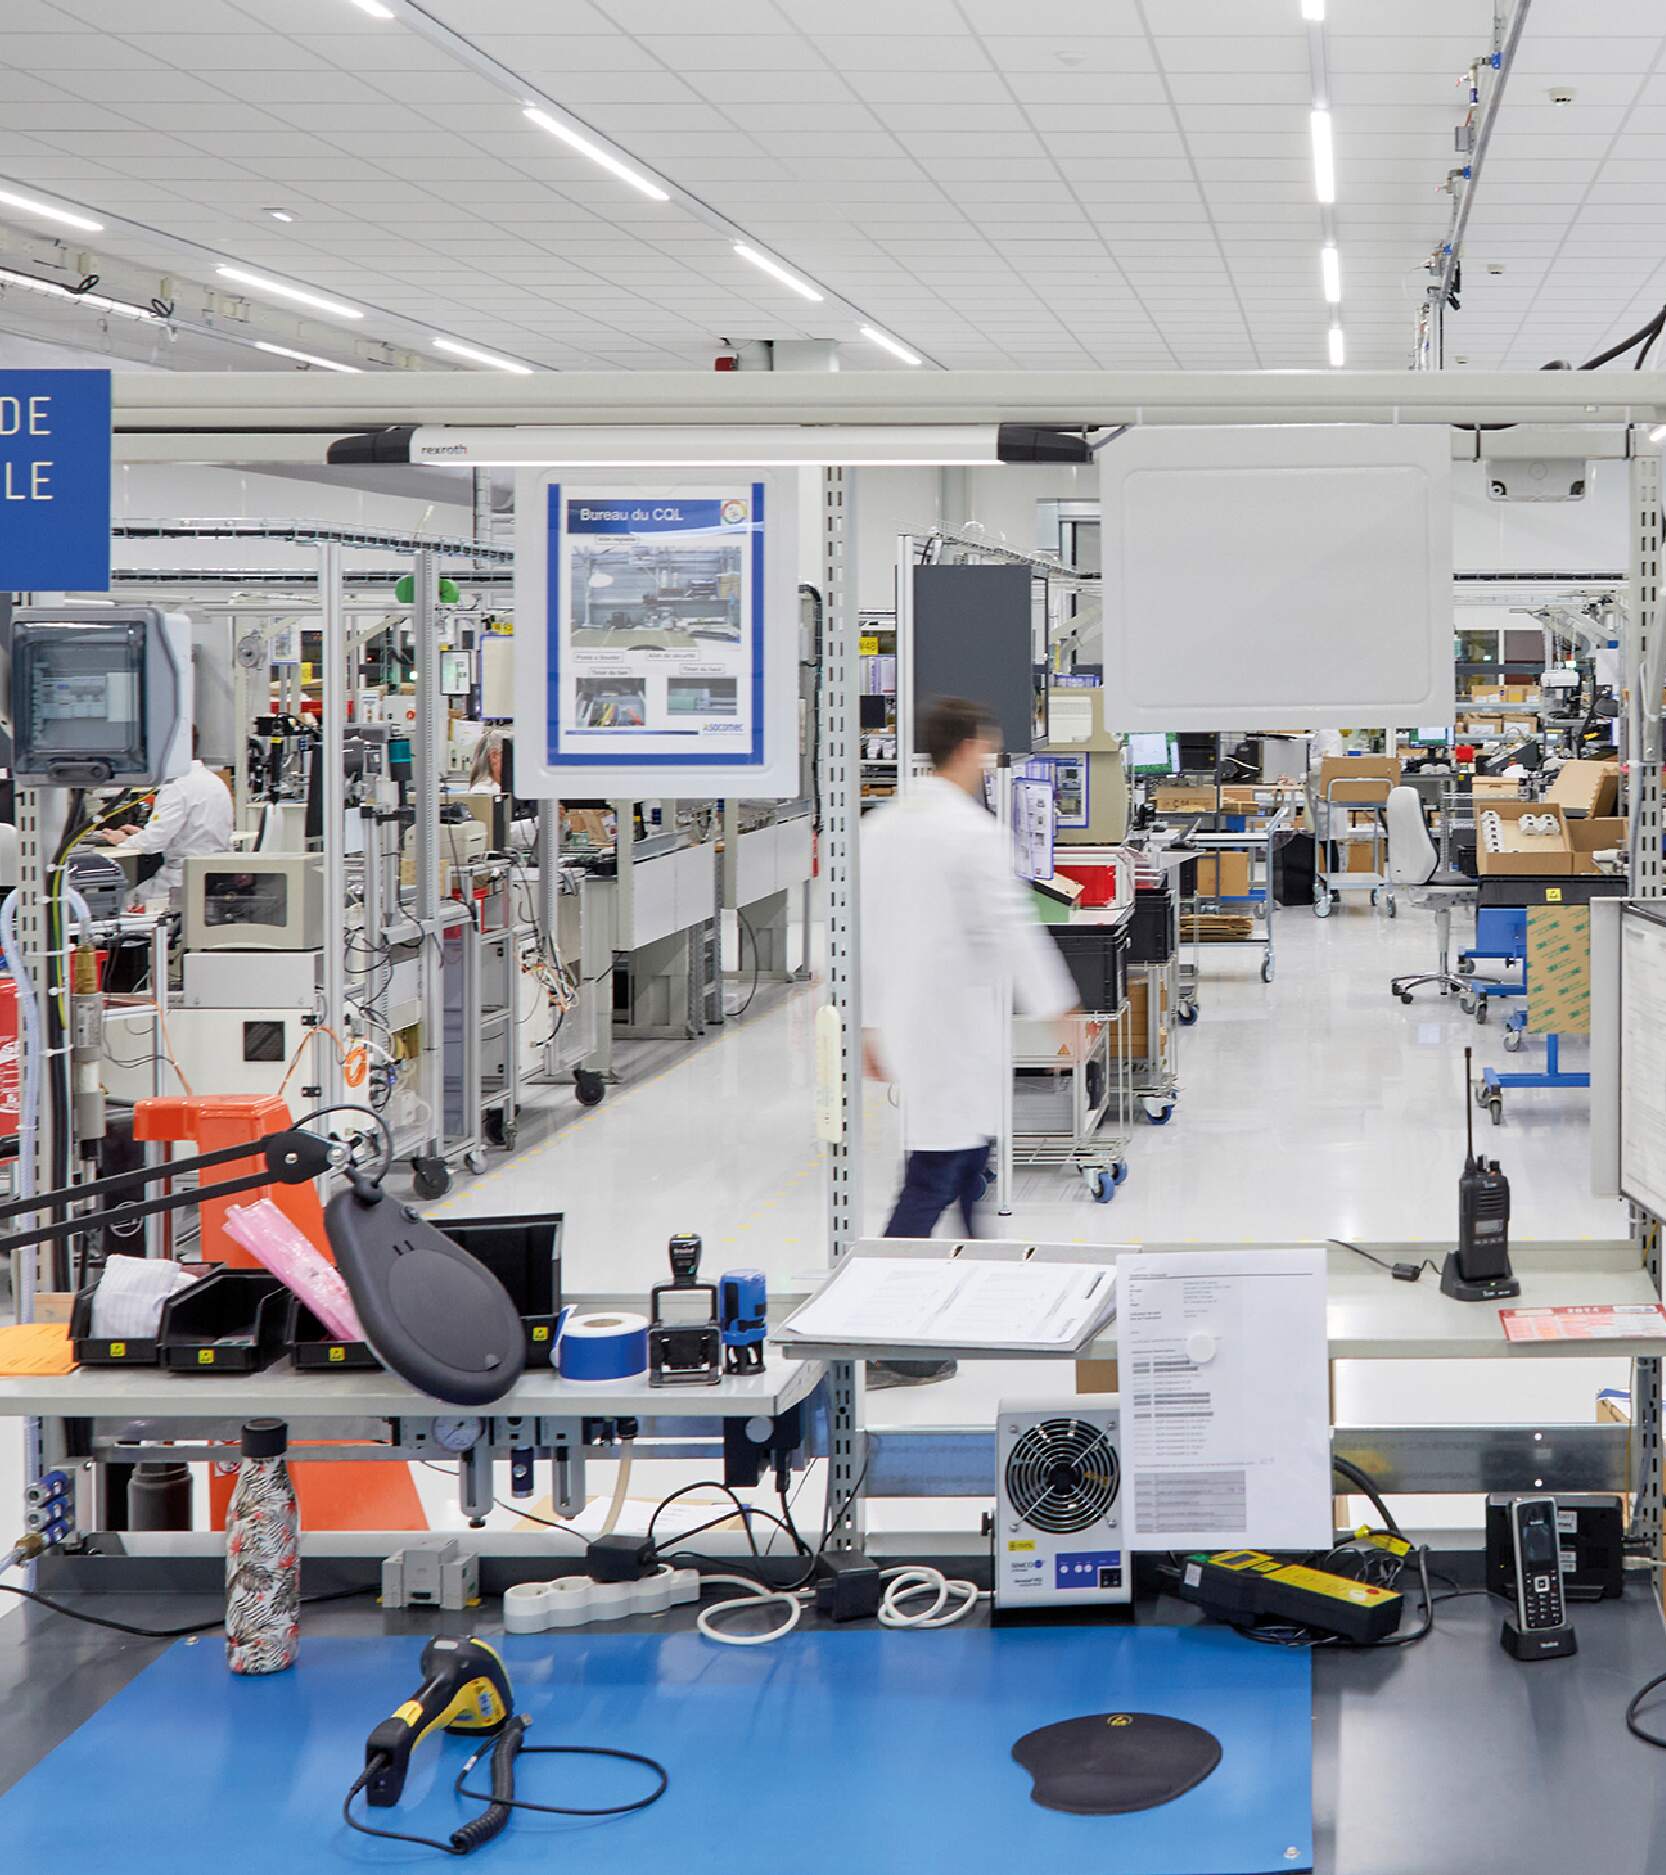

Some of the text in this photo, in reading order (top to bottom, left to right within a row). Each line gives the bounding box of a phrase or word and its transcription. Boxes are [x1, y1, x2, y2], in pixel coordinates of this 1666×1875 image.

[0, 396, 52, 436] DE
[5, 462, 54, 500] LE
[580, 508, 684, 521] Bureau du CQL
